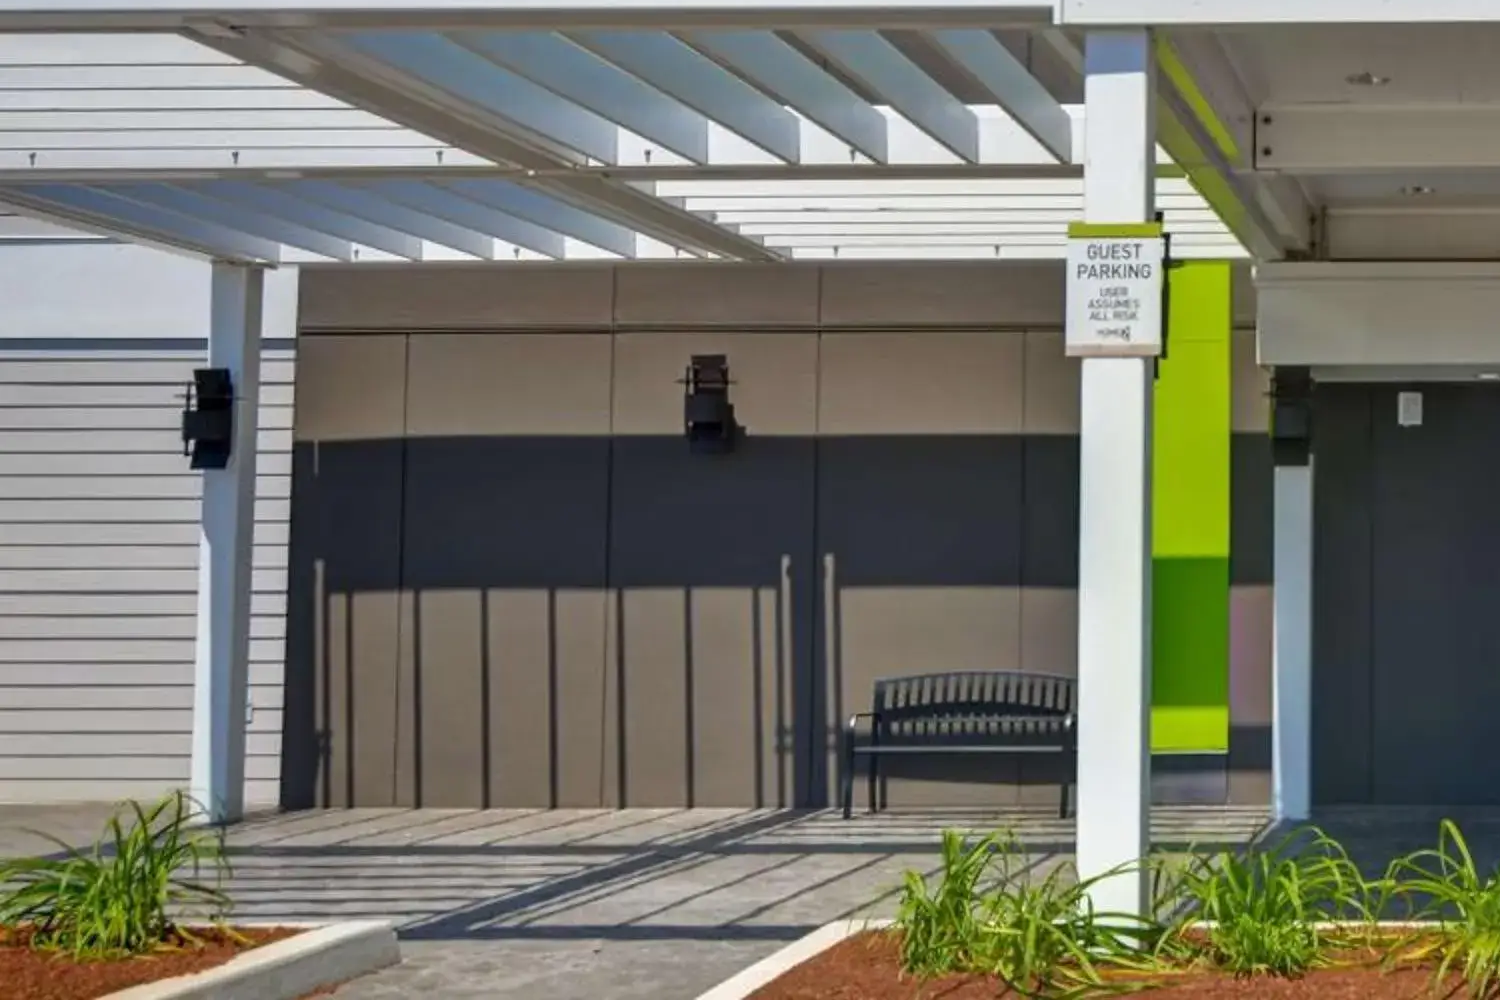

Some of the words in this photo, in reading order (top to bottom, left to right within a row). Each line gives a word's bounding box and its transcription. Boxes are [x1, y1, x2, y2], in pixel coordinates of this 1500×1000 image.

[1086, 243, 1143, 260] GUEST
[1077, 263, 1152, 280] PARKING
[1087, 298, 1141, 309] ASSUMES
